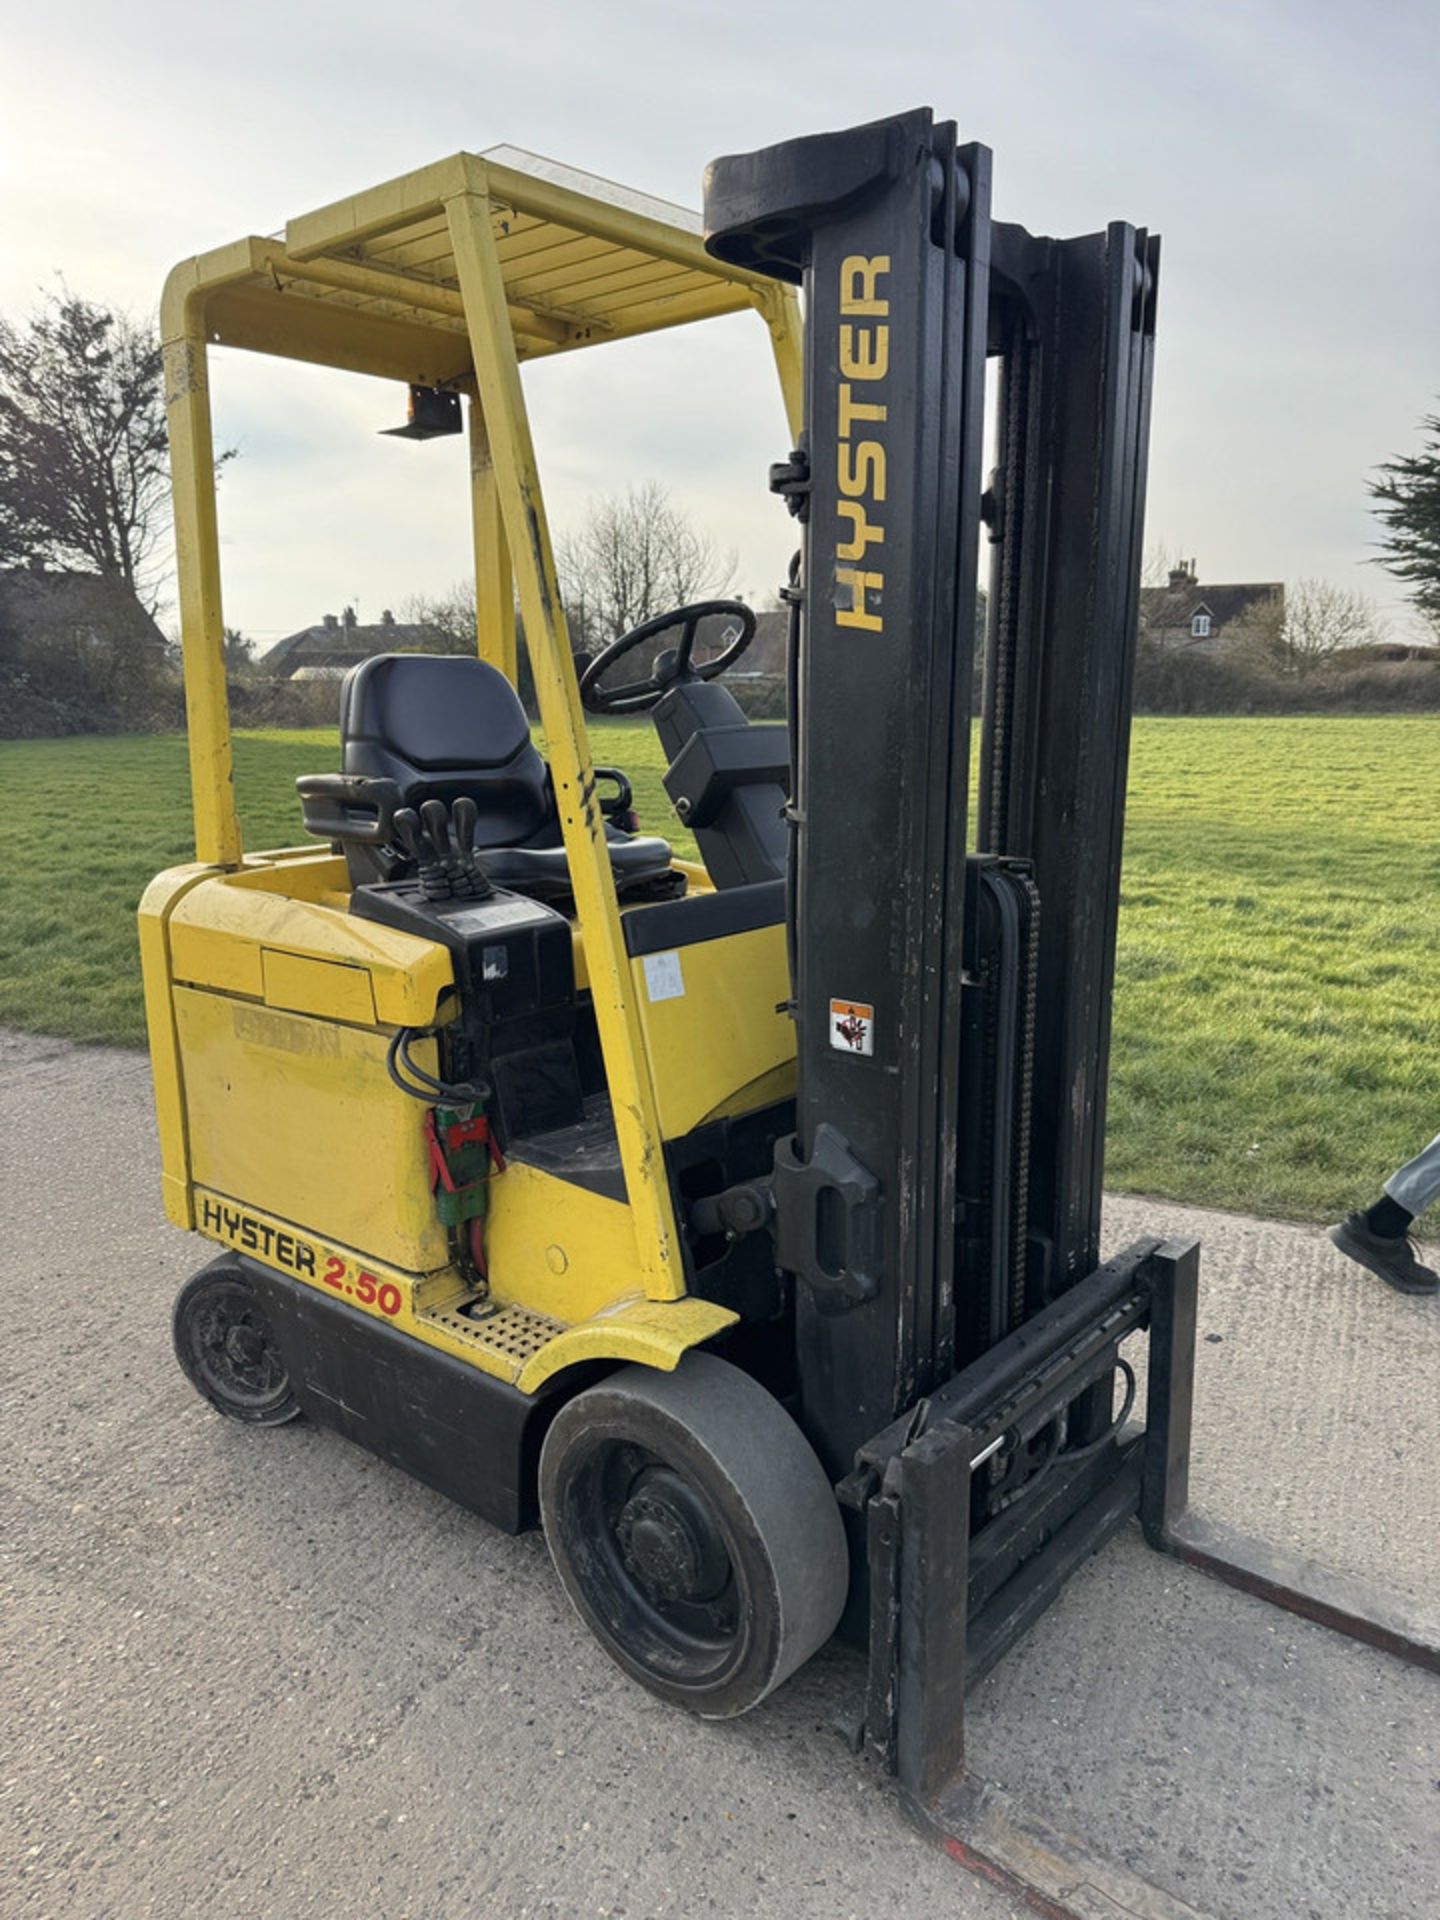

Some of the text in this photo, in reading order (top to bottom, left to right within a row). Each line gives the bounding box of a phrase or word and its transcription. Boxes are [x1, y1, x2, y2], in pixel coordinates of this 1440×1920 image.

[835, 255, 891, 632] HYSTER
[203, 1199, 403, 1316] HYSTER 2.50
